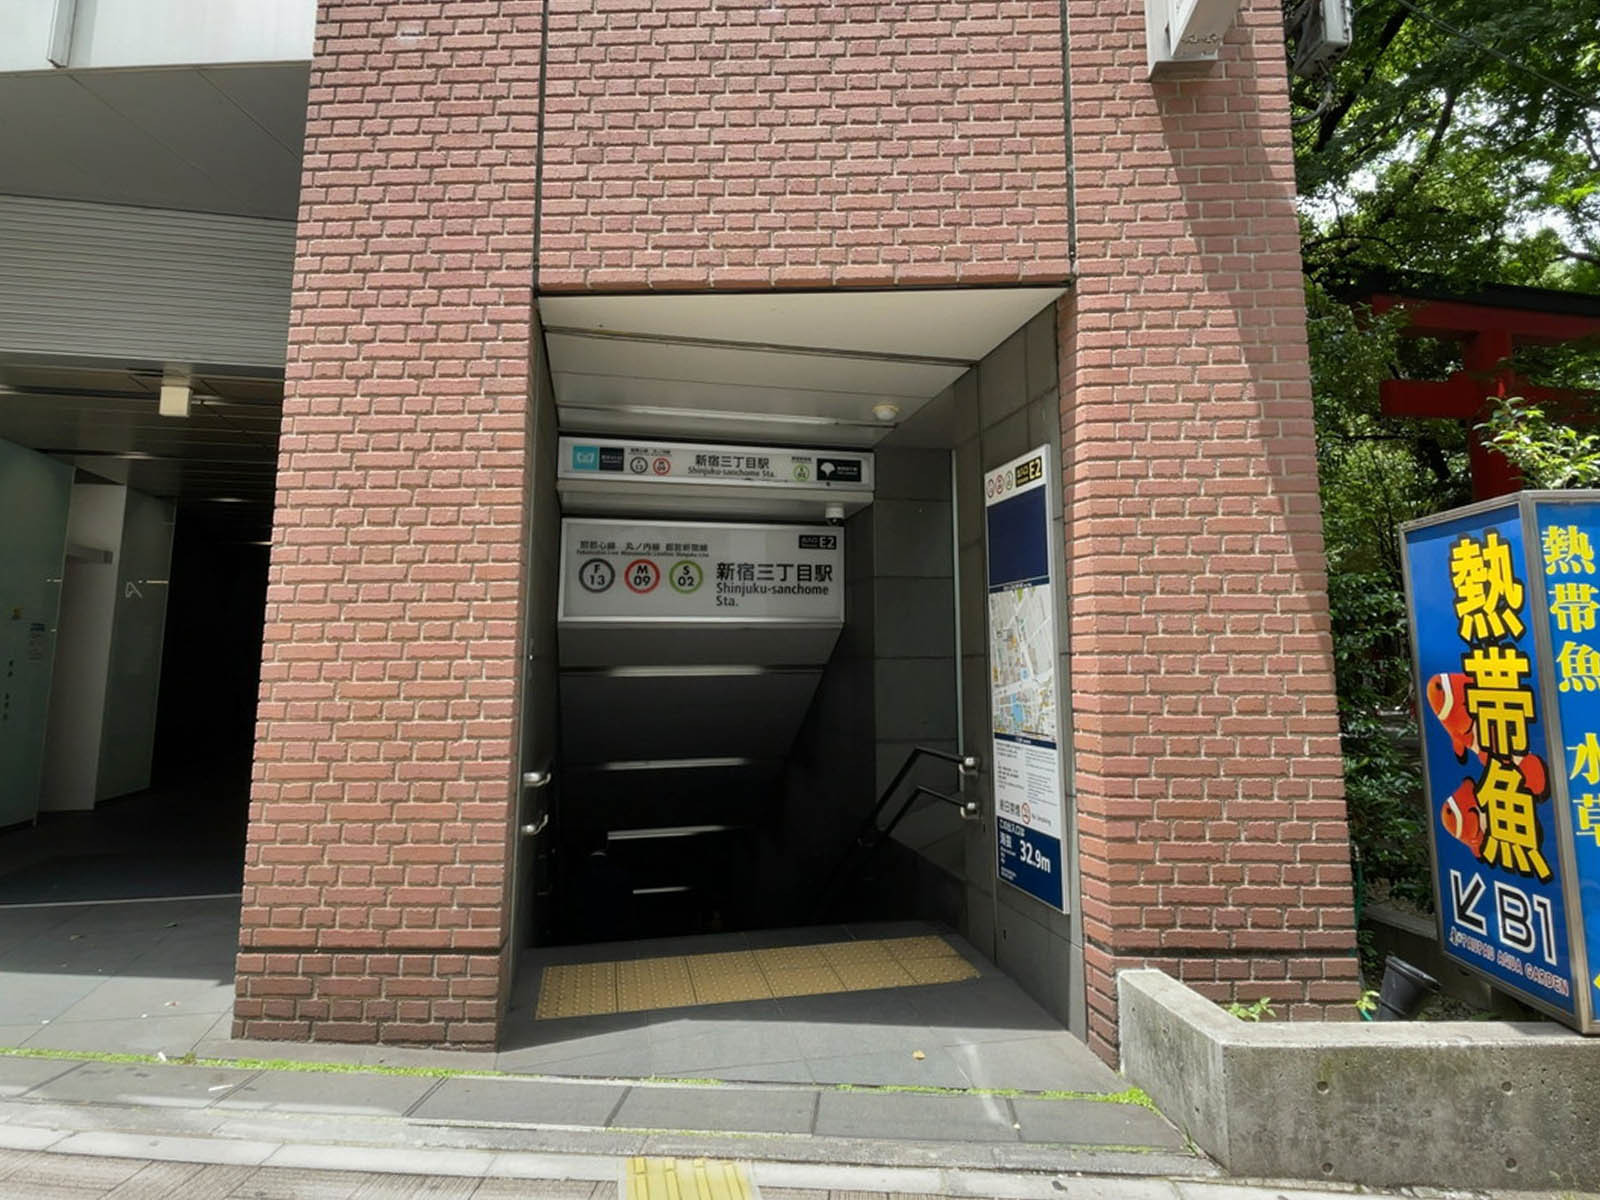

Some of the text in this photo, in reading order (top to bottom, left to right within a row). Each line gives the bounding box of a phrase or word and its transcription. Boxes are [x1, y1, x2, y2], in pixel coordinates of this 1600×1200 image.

[695, 454, 770, 469] 新宿三丁目駅
[1029, 459, 1041, 479] E2
[819, 536, 835, 549] E2
[594, 564, 601, 573] F
[636, 565, 648, 574] M
[682, 565, 690, 575] S
[716, 562, 833, 582] 新宿三丁目駅
[590, 575, 605, 585] 13
[634, 575, 651, 586] 09
[678, 576, 694, 586] 02
[716, 582, 829, 597] Shinjuku-sanchome
[716, 595, 739, 607] Sta.
[1542, 525, 1600, 692] 熱帯魚
[1451, 532, 1552, 879] 熱帯魚
[1020, 839, 1051, 873] 32.9m
[1494, 880, 1557, 966] B1
[1525, 962, 1569, 997] GARDEN
